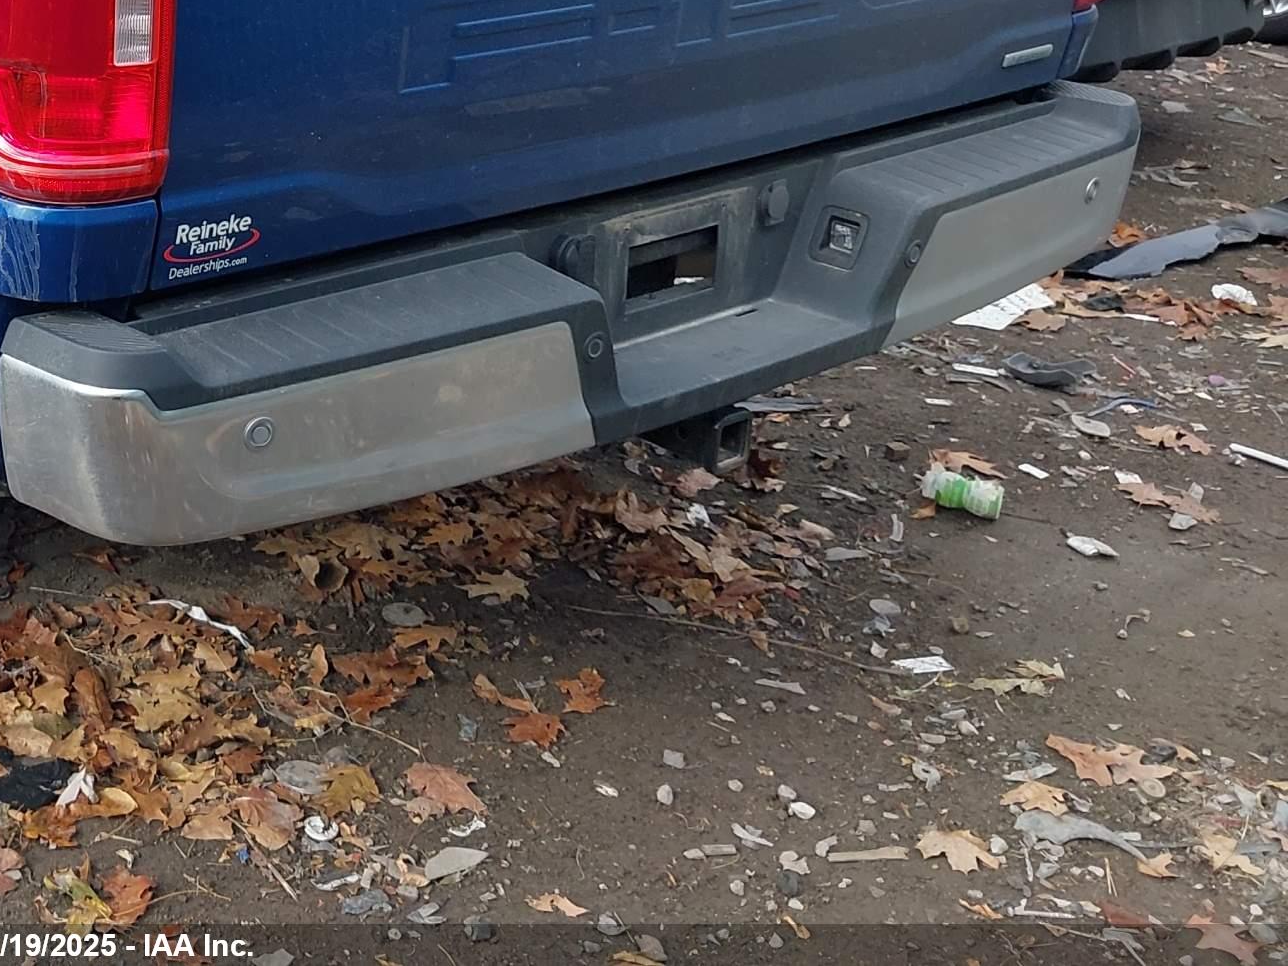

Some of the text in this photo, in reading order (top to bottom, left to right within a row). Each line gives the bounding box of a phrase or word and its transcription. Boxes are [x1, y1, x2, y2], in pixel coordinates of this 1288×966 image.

[175, 214, 253, 245] Reineke
[189, 235, 237, 256] Family
[168, 256, 248, 280] Dealerships.com
